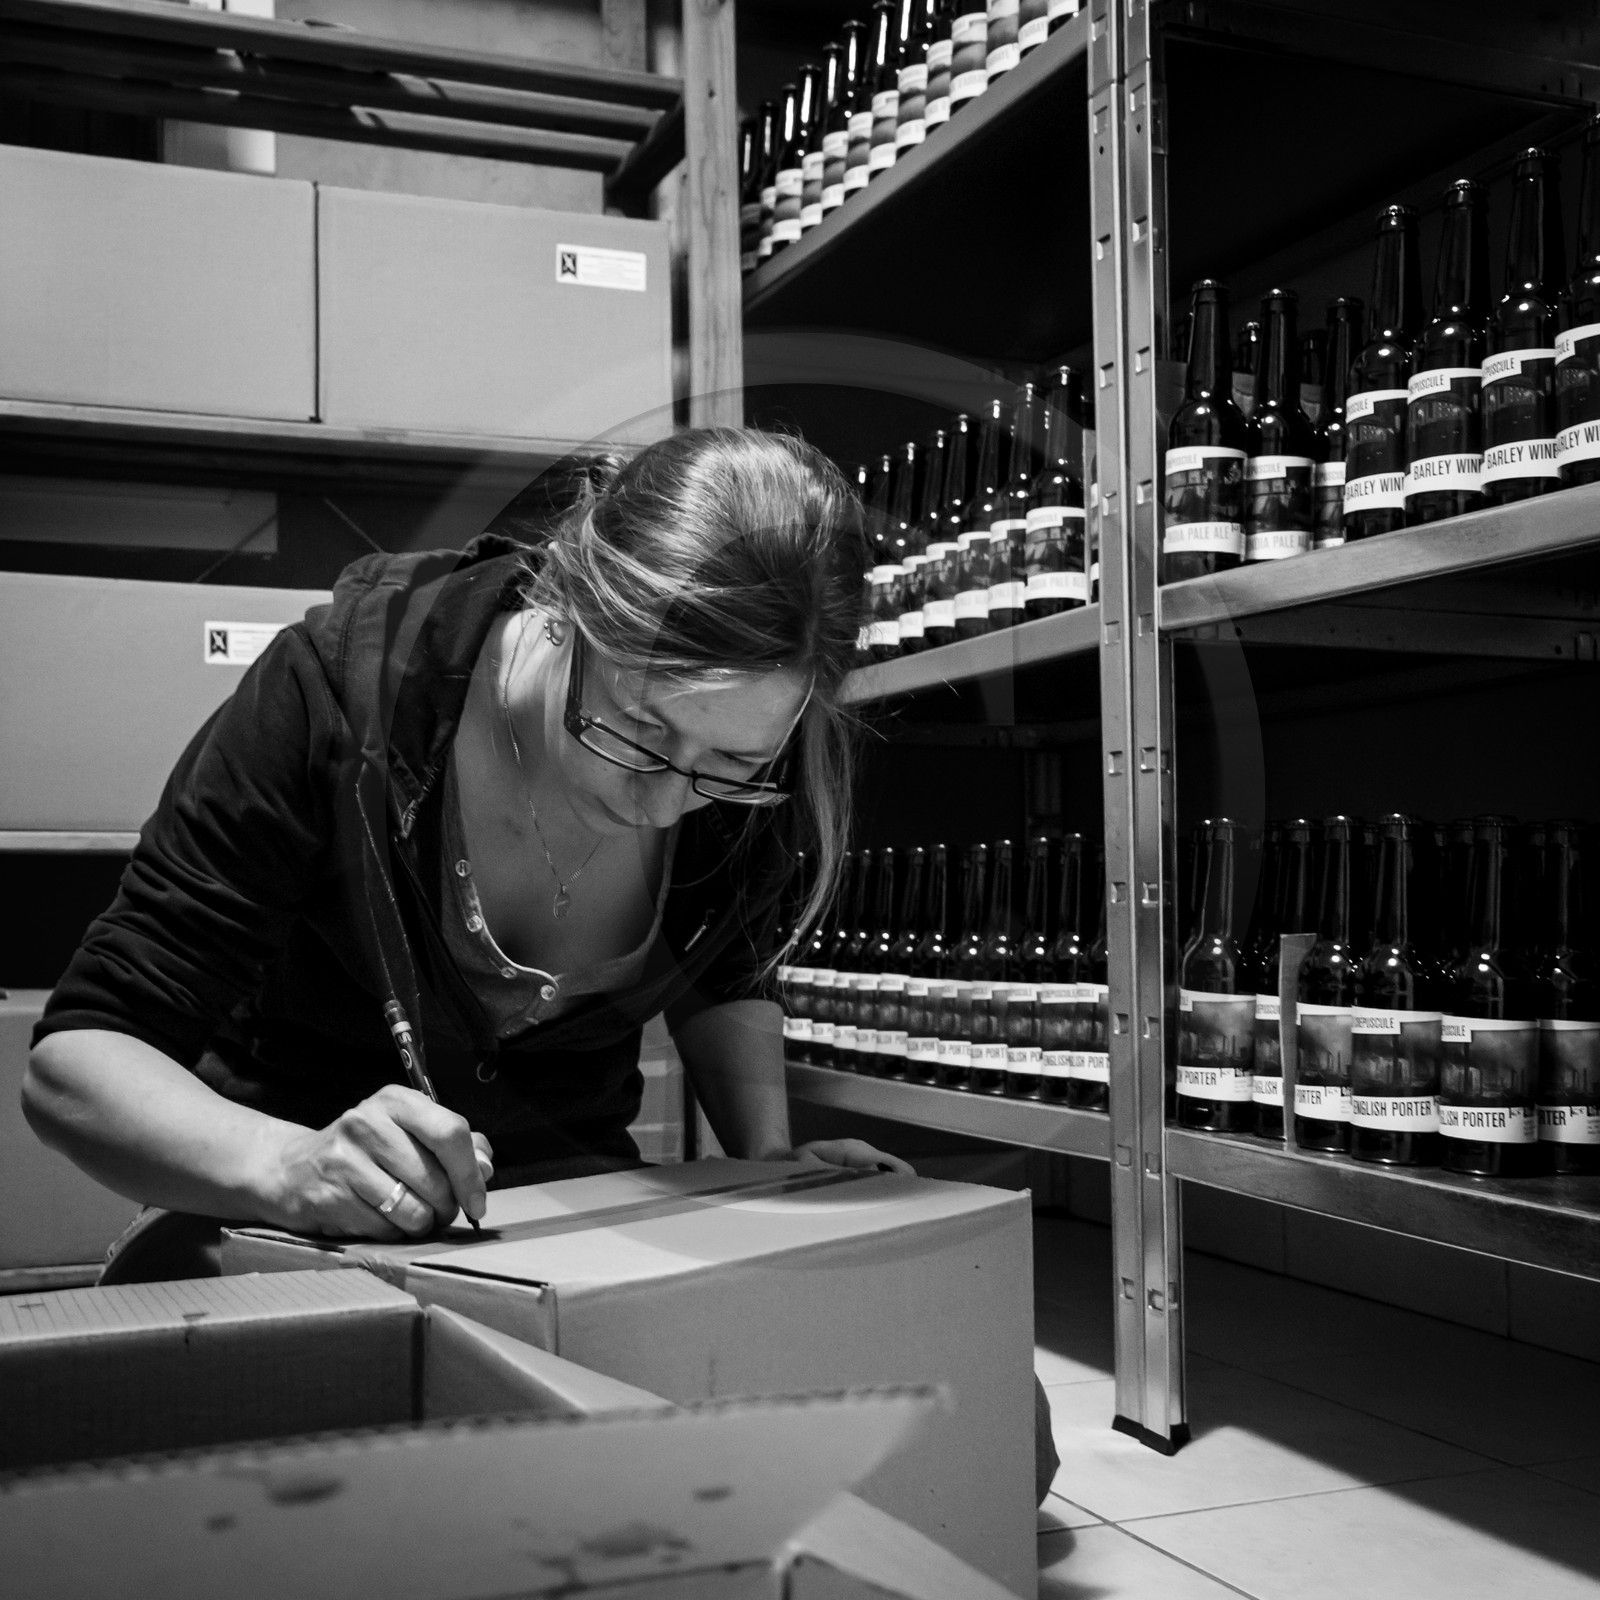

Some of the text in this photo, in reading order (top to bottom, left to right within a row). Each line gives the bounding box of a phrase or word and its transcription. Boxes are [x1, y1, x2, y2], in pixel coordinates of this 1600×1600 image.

[1487, 445, 1524, 470] BARLEY
[1413, 459, 1451, 481] BARLEY
[1346, 479, 1376, 502] BARLEY
[1187, 526, 1209, 540] PALE
[1213, 526, 1229, 540] ALE
[1273, 534, 1295, 548] PALE
[1184, 1070, 1217, 1086] PORTER
[1353, 1099, 1387, 1117] ENGLISH
[1392, 1100, 1432, 1117] PORTER
[1462, 1111, 1506, 1128] PORTER
